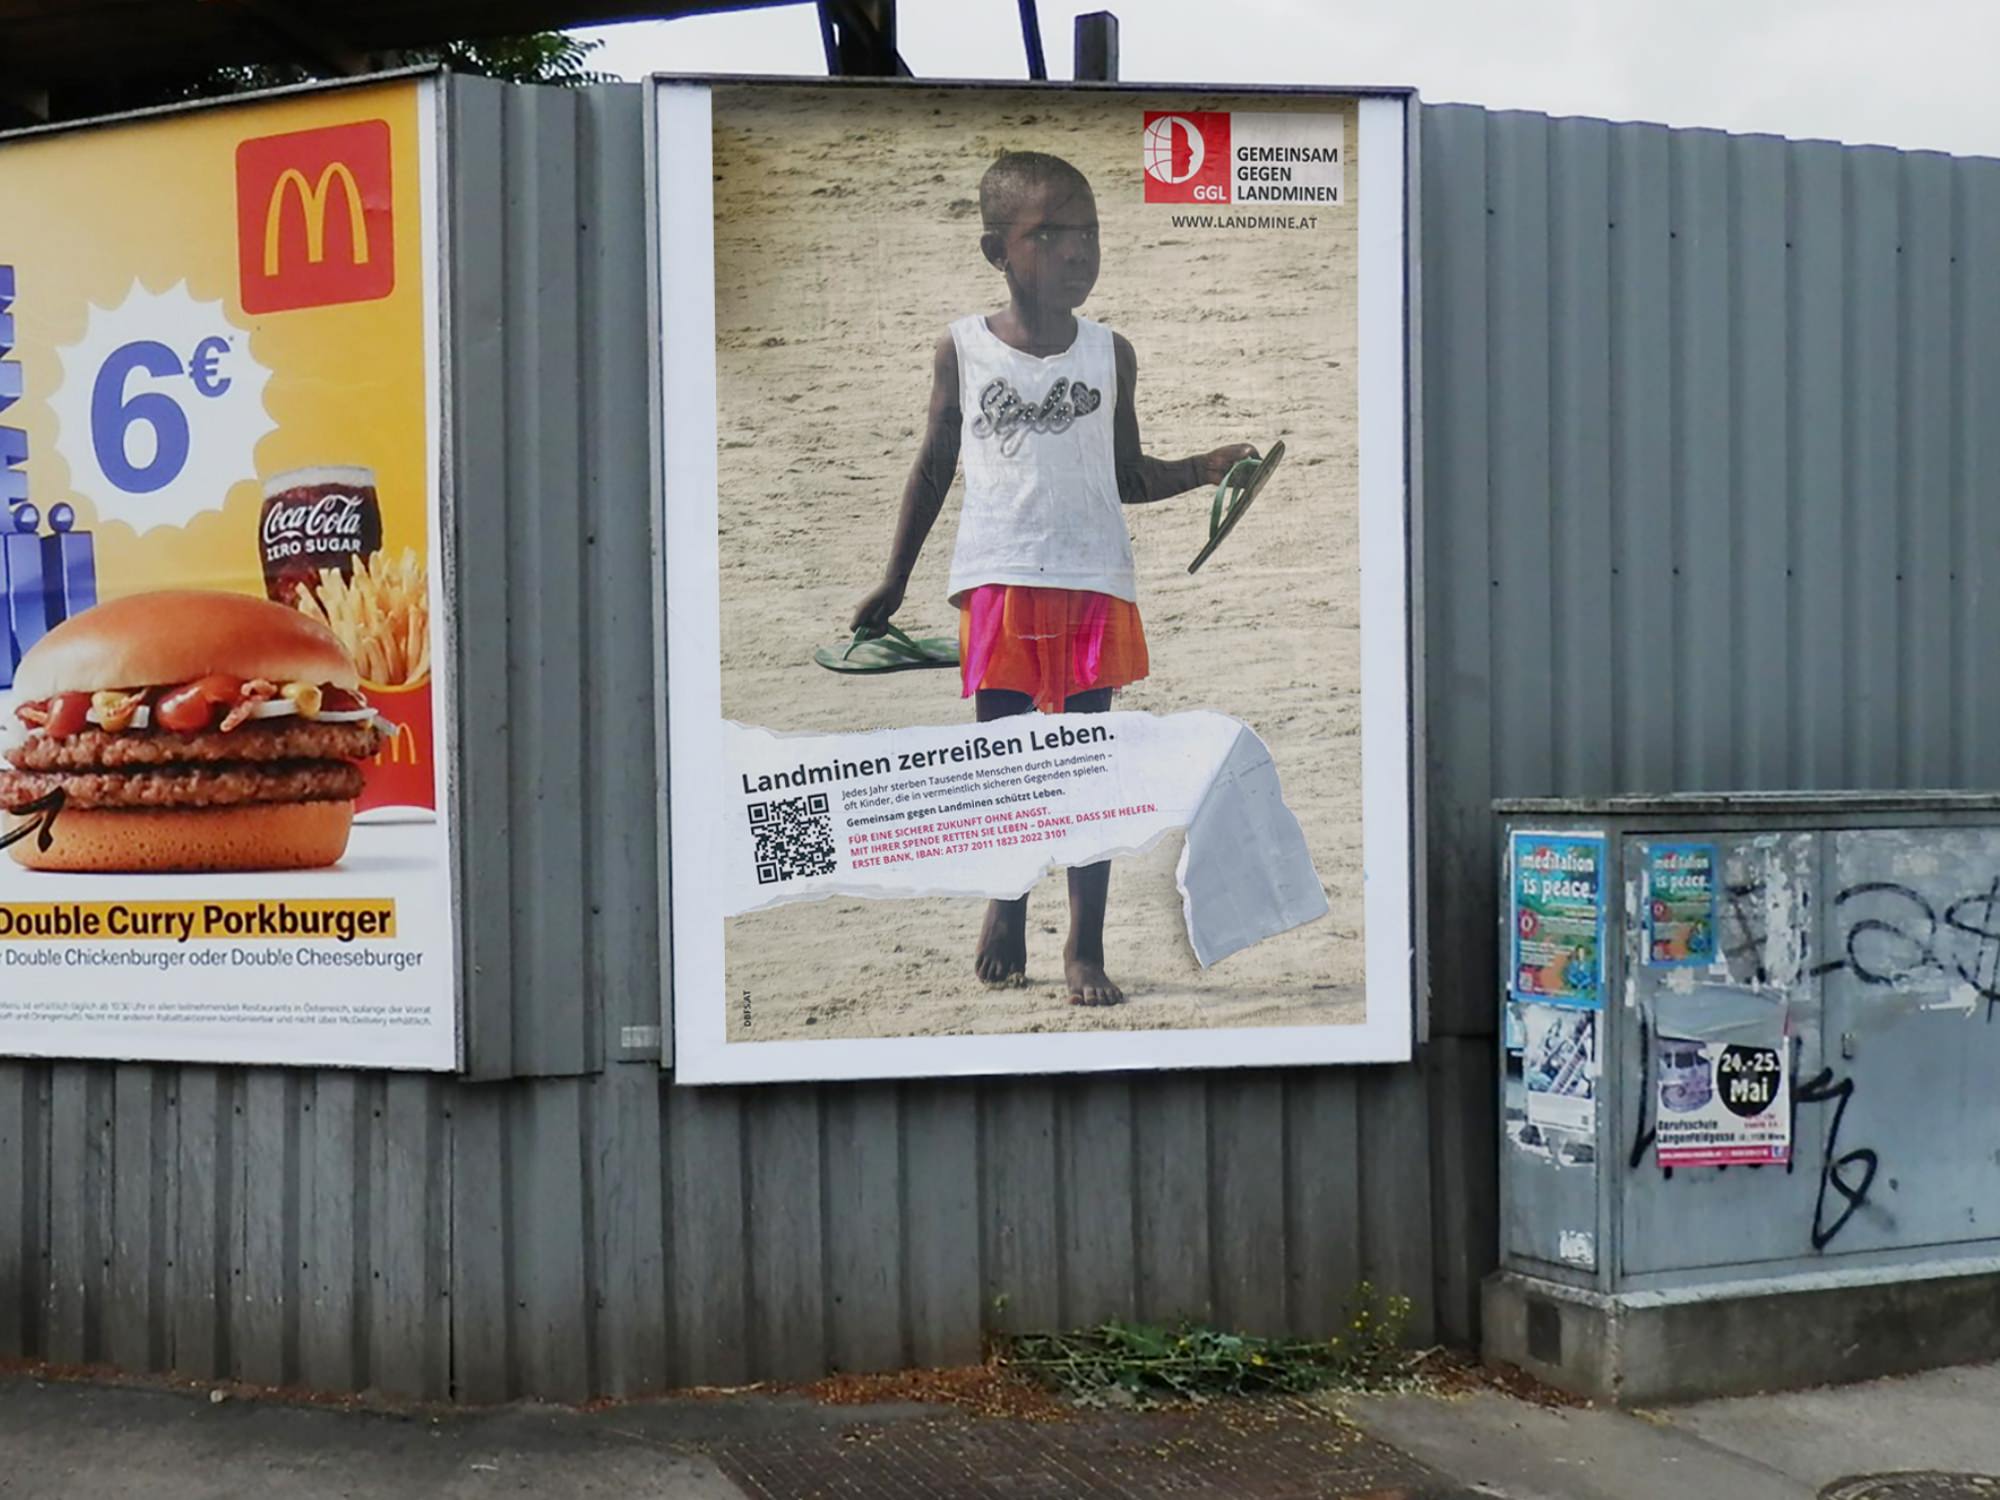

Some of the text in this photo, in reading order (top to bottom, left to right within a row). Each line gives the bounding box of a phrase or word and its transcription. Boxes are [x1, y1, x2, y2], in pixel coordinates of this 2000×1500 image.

[1237, 146, 1338, 162] GEMEINSAM
[1237, 166, 1292, 182] GEGEN
[1193, 185, 1227, 200] GGL
[1237, 185, 1338, 201] LANDMINEN
[1171, 215, 1318, 229] WWW.LANDMINE.AT
[263, 493, 364, 544] Coca-Cola
[266, 537, 362, 562] ZERO SUGAR
[742, 725, 1115, 794] Landminen zerreißen Leben.
[841, 786, 868, 800] Jedes
[870, 783, 888, 796] Jahr
[890, 779, 926, 792] sterben
[929, 771, 974, 786] Tausende
[976, 764, 1023, 779] Menschen
[1025, 760, 1052, 772] durch
[1055, 753, 1106, 768] Landminen
[844, 764, 1108, 811] oft Kinder, die in vermeintlich sicheren Gegenden spielen.
[846, 787, 1066, 828] Gemeinsam gegen Landminen schützt Leben.
[848, 806, 1051, 845] FÜR EINE SICHERE ZUKUNFT OHNE ANGST.
[850, 846, 868, 857] MIT
[871, 842, 900, 854] IHRER
[902, 835, 940, 849] SPENDE
[943, 829, 979, 843] RETTEN
[981, 827, 996, 838] SIE
[997, 822, 1028, 835] LEBEN
[1037, 816, 1074, 830] DANKE,
[1076, 812, 1101, 824] DASS
[1102, 809, 1117, 820] SIE
[1119, 803, 1158, 817] HELFEN.
[852, 828, 1067, 870] ERSTE BANK, IBAN: AT37 2011 1823 2022 3101
[1519, 848, 1594, 872] meditation
[1523, 873, 1537, 894] is
[0, 902, 391, 943] Double Curry Porkburger
[6, 949, 62, 966] Double
[64, 948, 185, 971] Chickenburger
[189, 948, 228, 966] oder
[231, 948, 293, 966] Double
[296, 948, 423, 972] Cheeseburger
[1730, 1077, 1769, 1103] Mai
